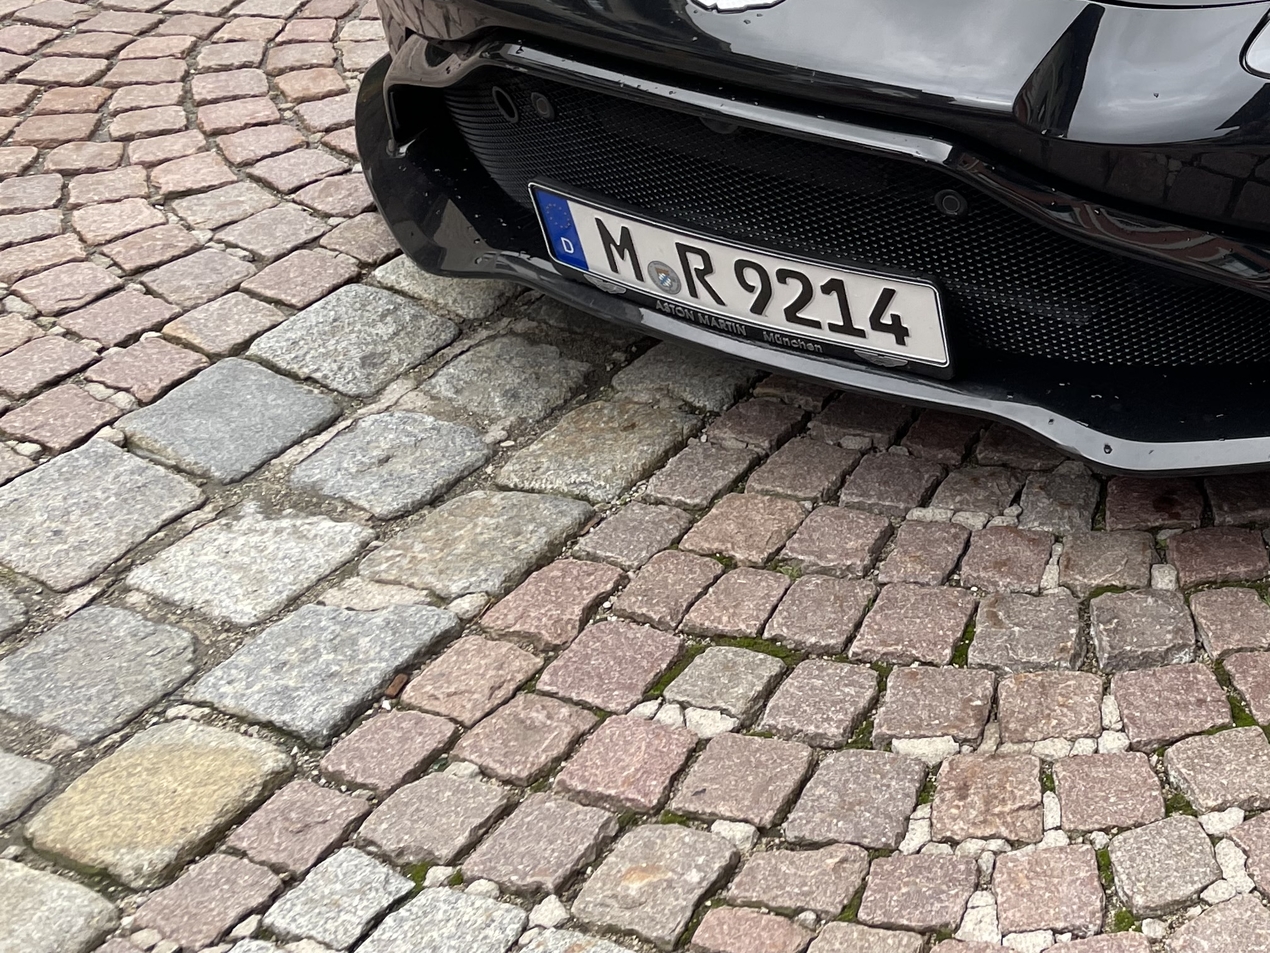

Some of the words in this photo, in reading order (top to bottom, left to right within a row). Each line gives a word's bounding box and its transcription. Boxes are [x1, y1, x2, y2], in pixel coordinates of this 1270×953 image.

[561, 237, 575, 254] D
[655, 300, 695, 322] ASTON
[697, 313, 747, 336] MARTIN
[763, 331, 824, 353] München
[733, 259, 910, 346] 9214
